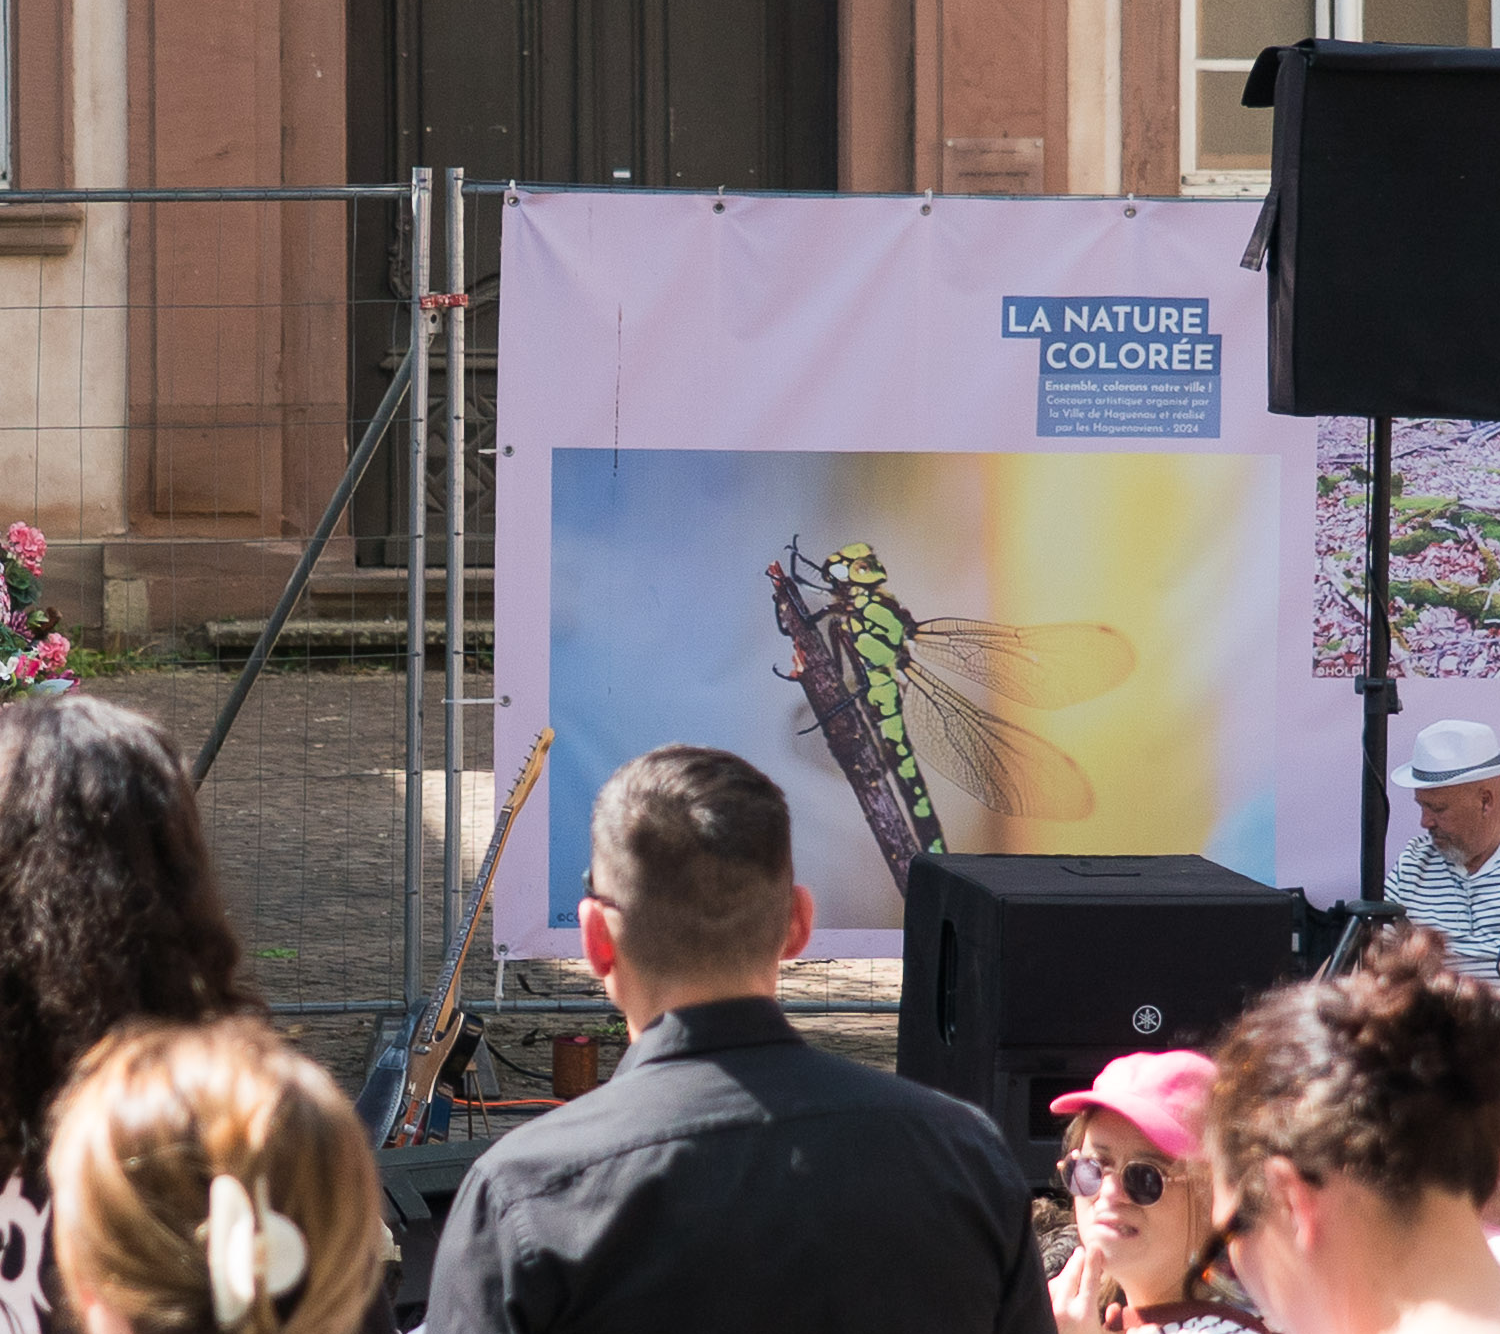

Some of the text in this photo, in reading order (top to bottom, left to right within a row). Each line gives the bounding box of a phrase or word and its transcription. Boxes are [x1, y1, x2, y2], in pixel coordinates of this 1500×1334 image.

[1008, 305, 1203, 335] LA NATURE
[1046, 340, 1214, 370] COLORÉE
[1045, 380, 1101, 393] Ensemble,
[1103, 380, 1148, 392] colorons
[1151, 382, 1180, 393] notre
[1184, 381, 1205, 393] ville
[1046, 395, 1210, 408] Concours artistique organisé par
[1049, 408, 1206, 421] la Ville de Haguenau et réalisé
[1055, 424, 1073, 434] par
[1076, 422, 1090, 432] les
[1093, 422, 1164, 434] Haguenaviens
[1173, 423, 1199, 434] 2024
